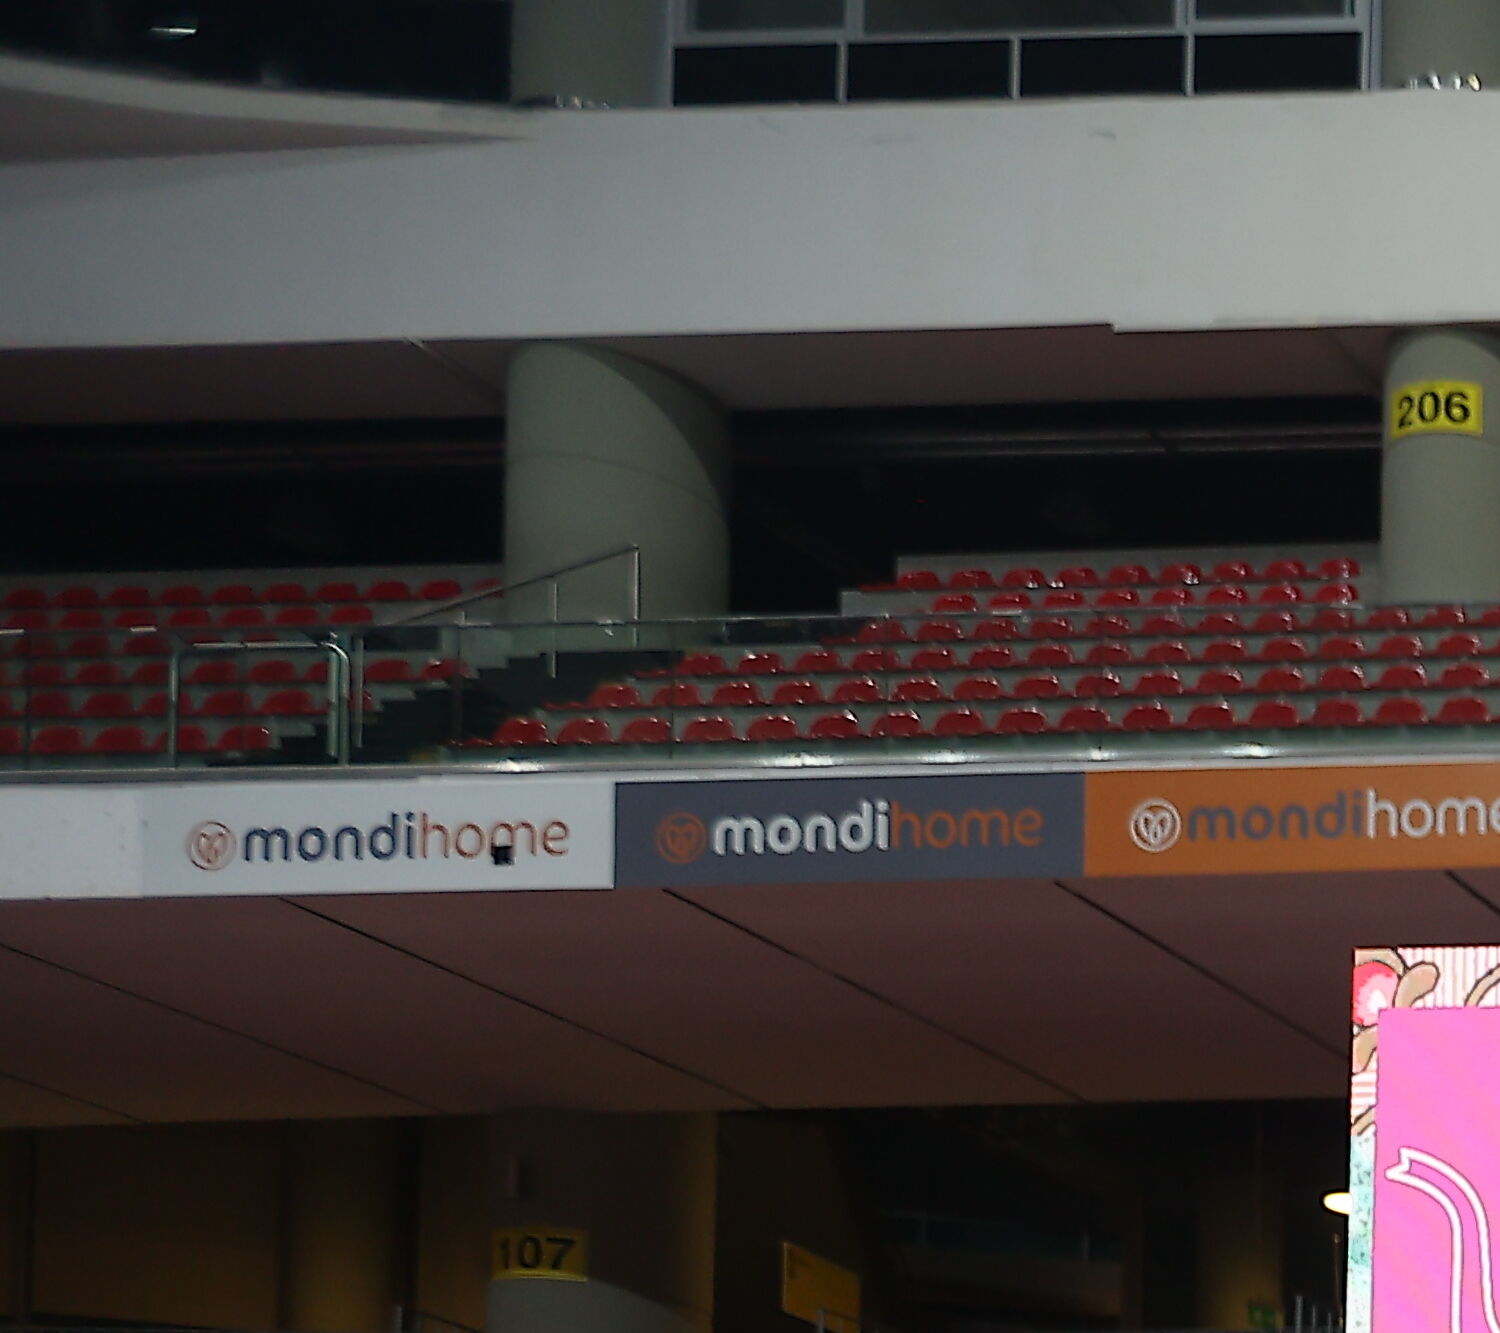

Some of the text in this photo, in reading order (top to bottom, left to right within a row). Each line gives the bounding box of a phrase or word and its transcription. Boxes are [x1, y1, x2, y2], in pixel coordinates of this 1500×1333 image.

[1398, 391, 1470, 429] 206
[243, 812, 569, 864] mondihome
[711, 799, 1043, 858] mondihome
[498, 1235, 576, 1270] 107
